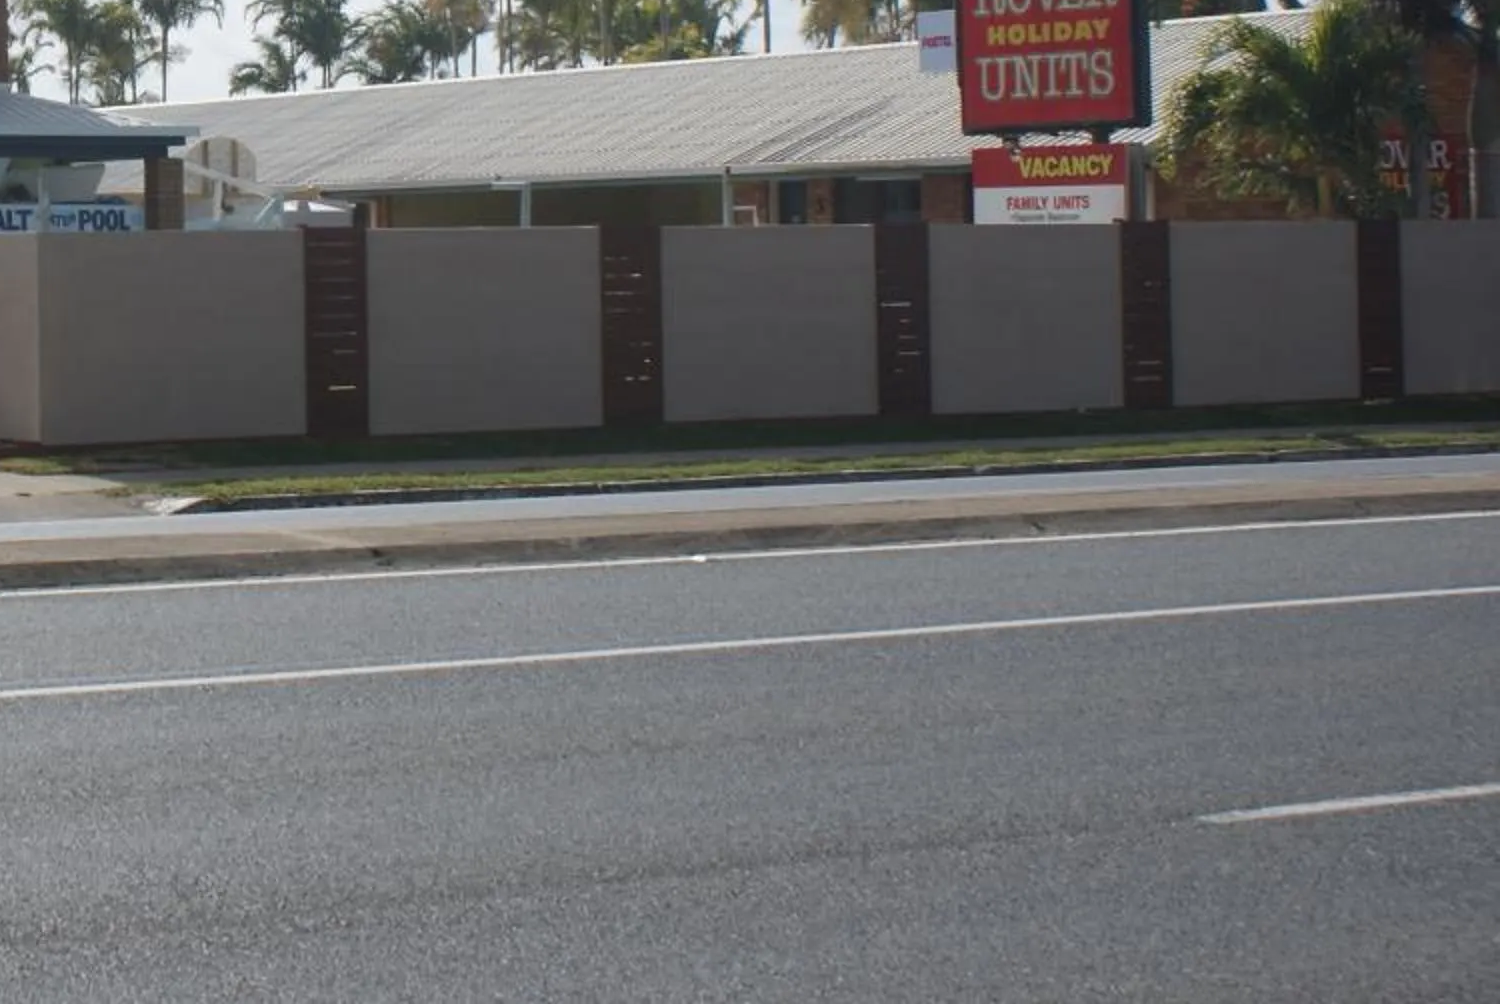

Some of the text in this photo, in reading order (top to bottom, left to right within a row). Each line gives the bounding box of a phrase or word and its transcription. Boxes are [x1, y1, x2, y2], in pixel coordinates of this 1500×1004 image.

[987, 19, 1111, 46] HOLIDAY
[975, 50, 1115, 101] UNITS
[1019, 154, 1113, 179] VACANCY
[1006, 195, 1090, 211] FAMILY UNITS
[78, 209, 131, 231] POOL
